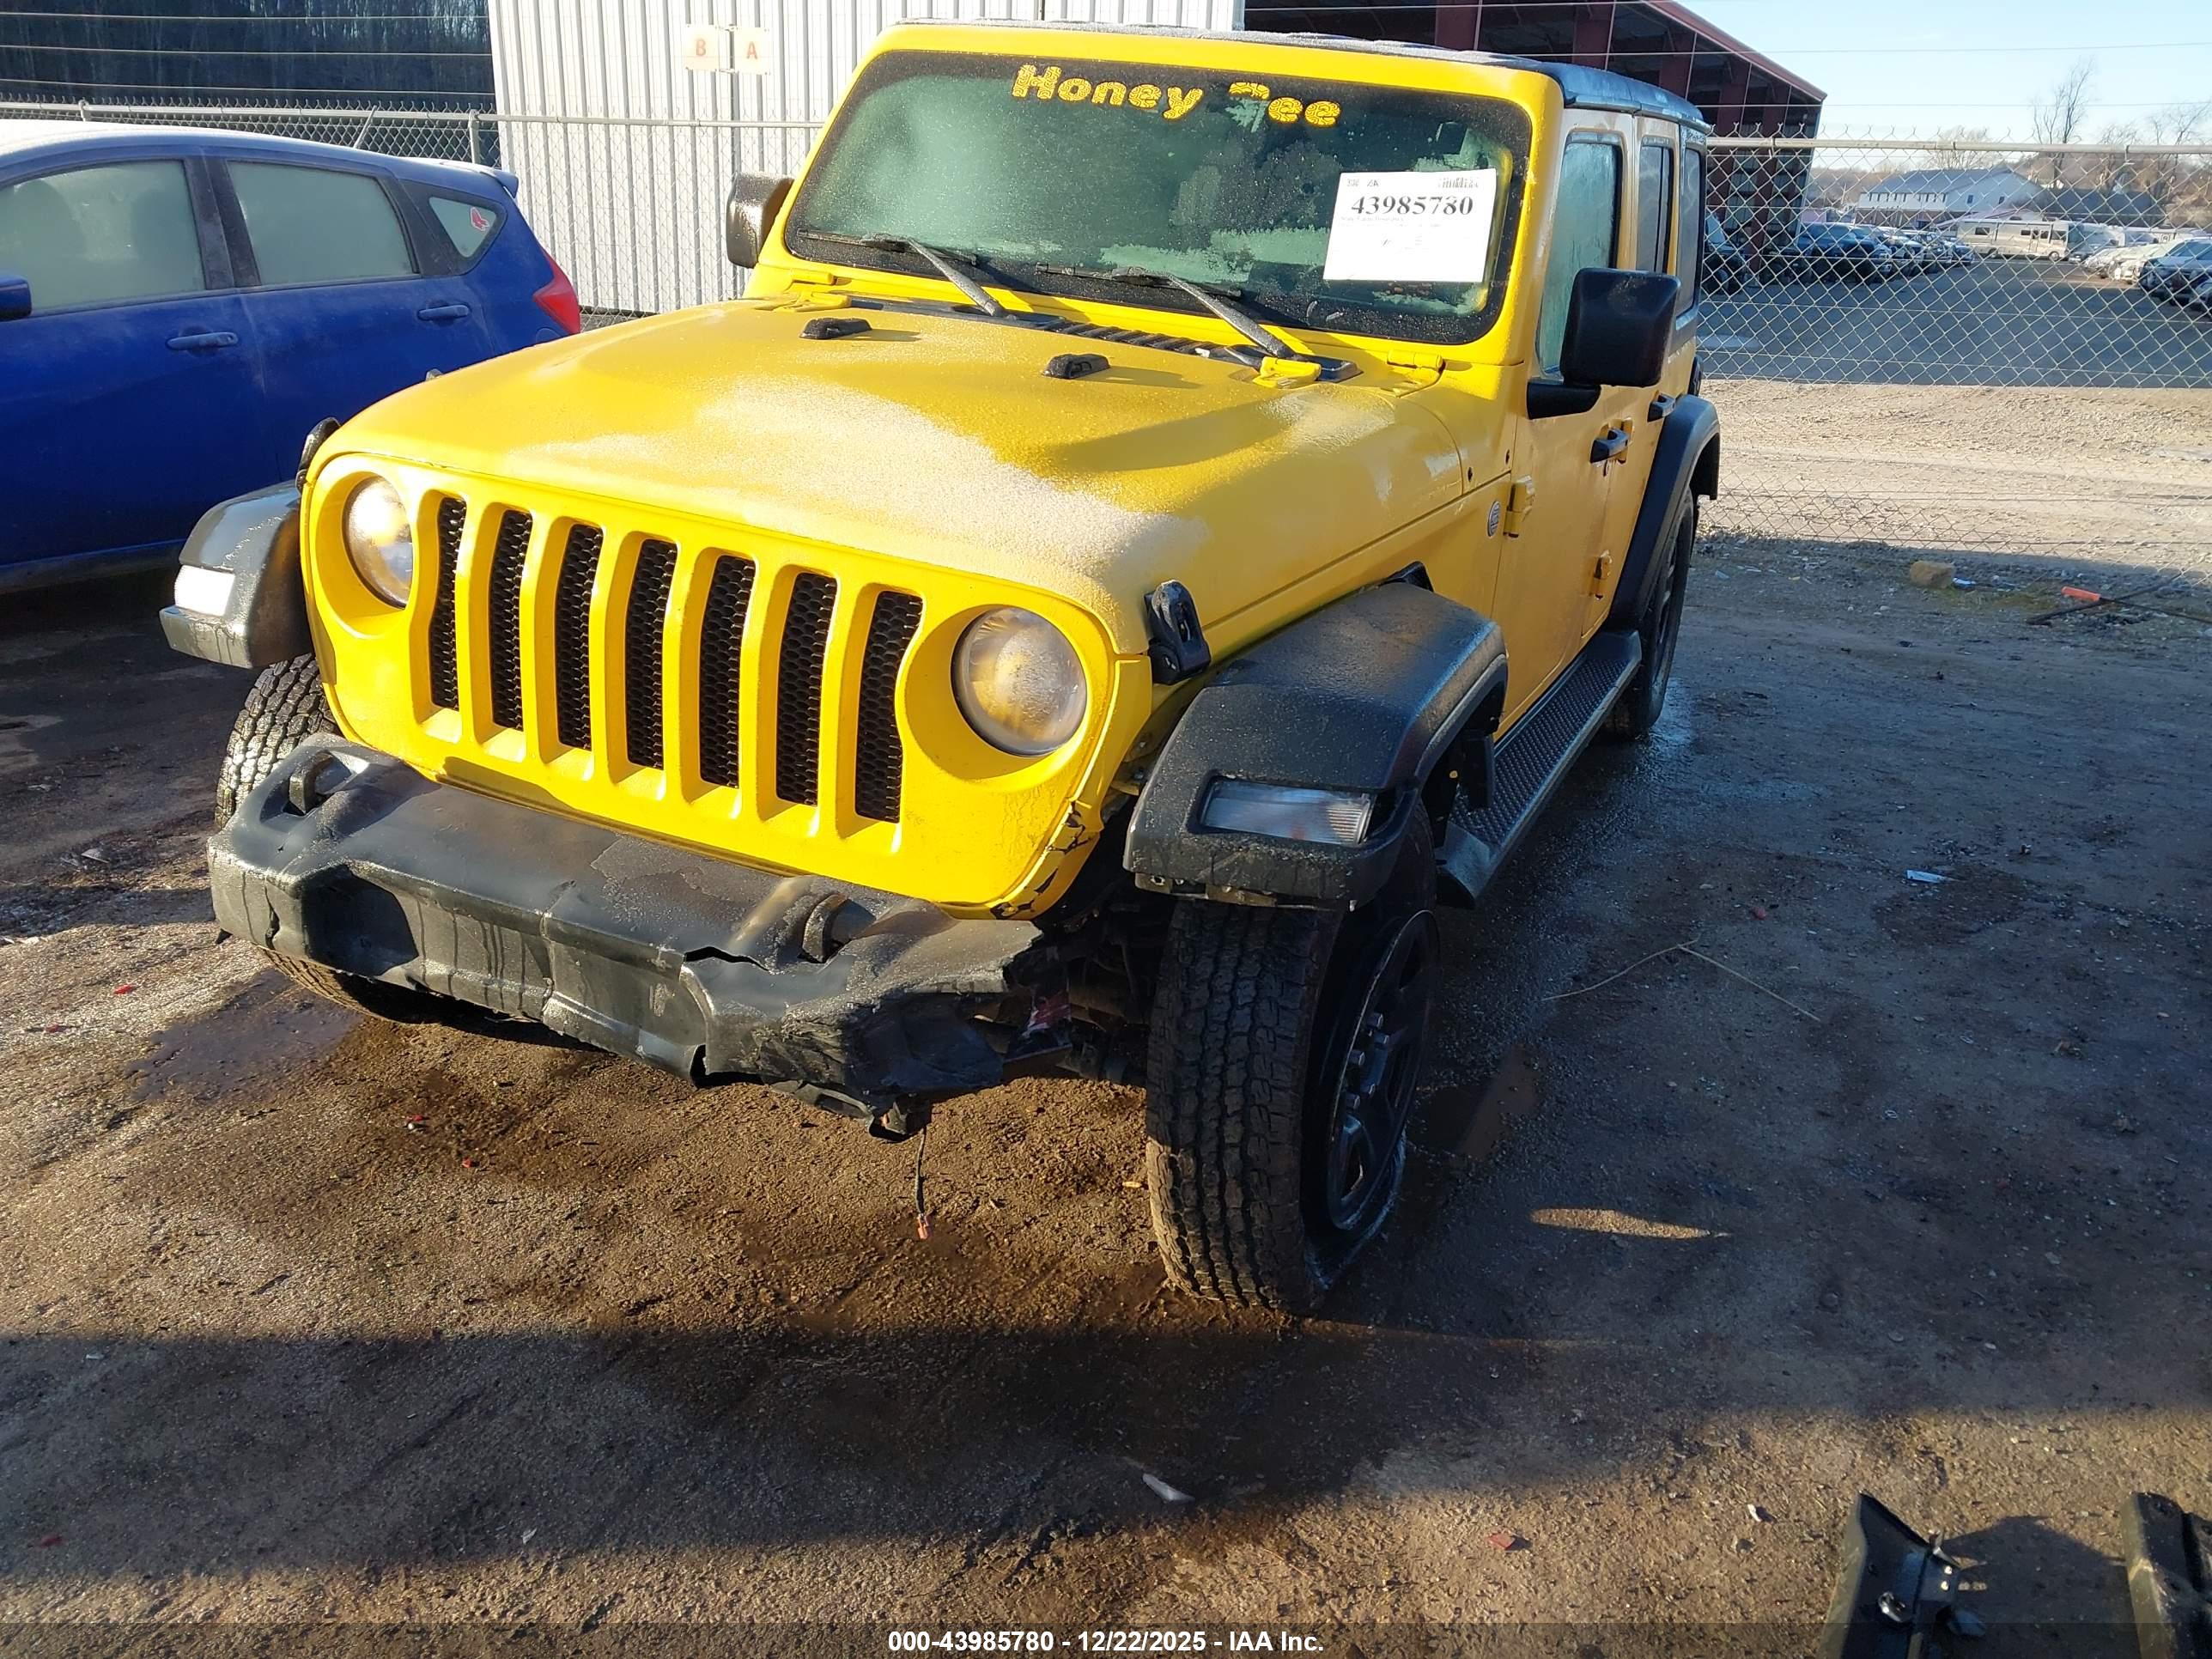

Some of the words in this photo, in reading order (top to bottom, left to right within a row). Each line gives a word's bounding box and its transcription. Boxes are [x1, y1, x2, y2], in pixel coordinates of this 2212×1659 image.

[696, 38, 707, 57] B
[746, 40, 758, 60] A
[1012, 64, 1203, 120] Honey
[1351, 195, 1474, 216] 43985780
